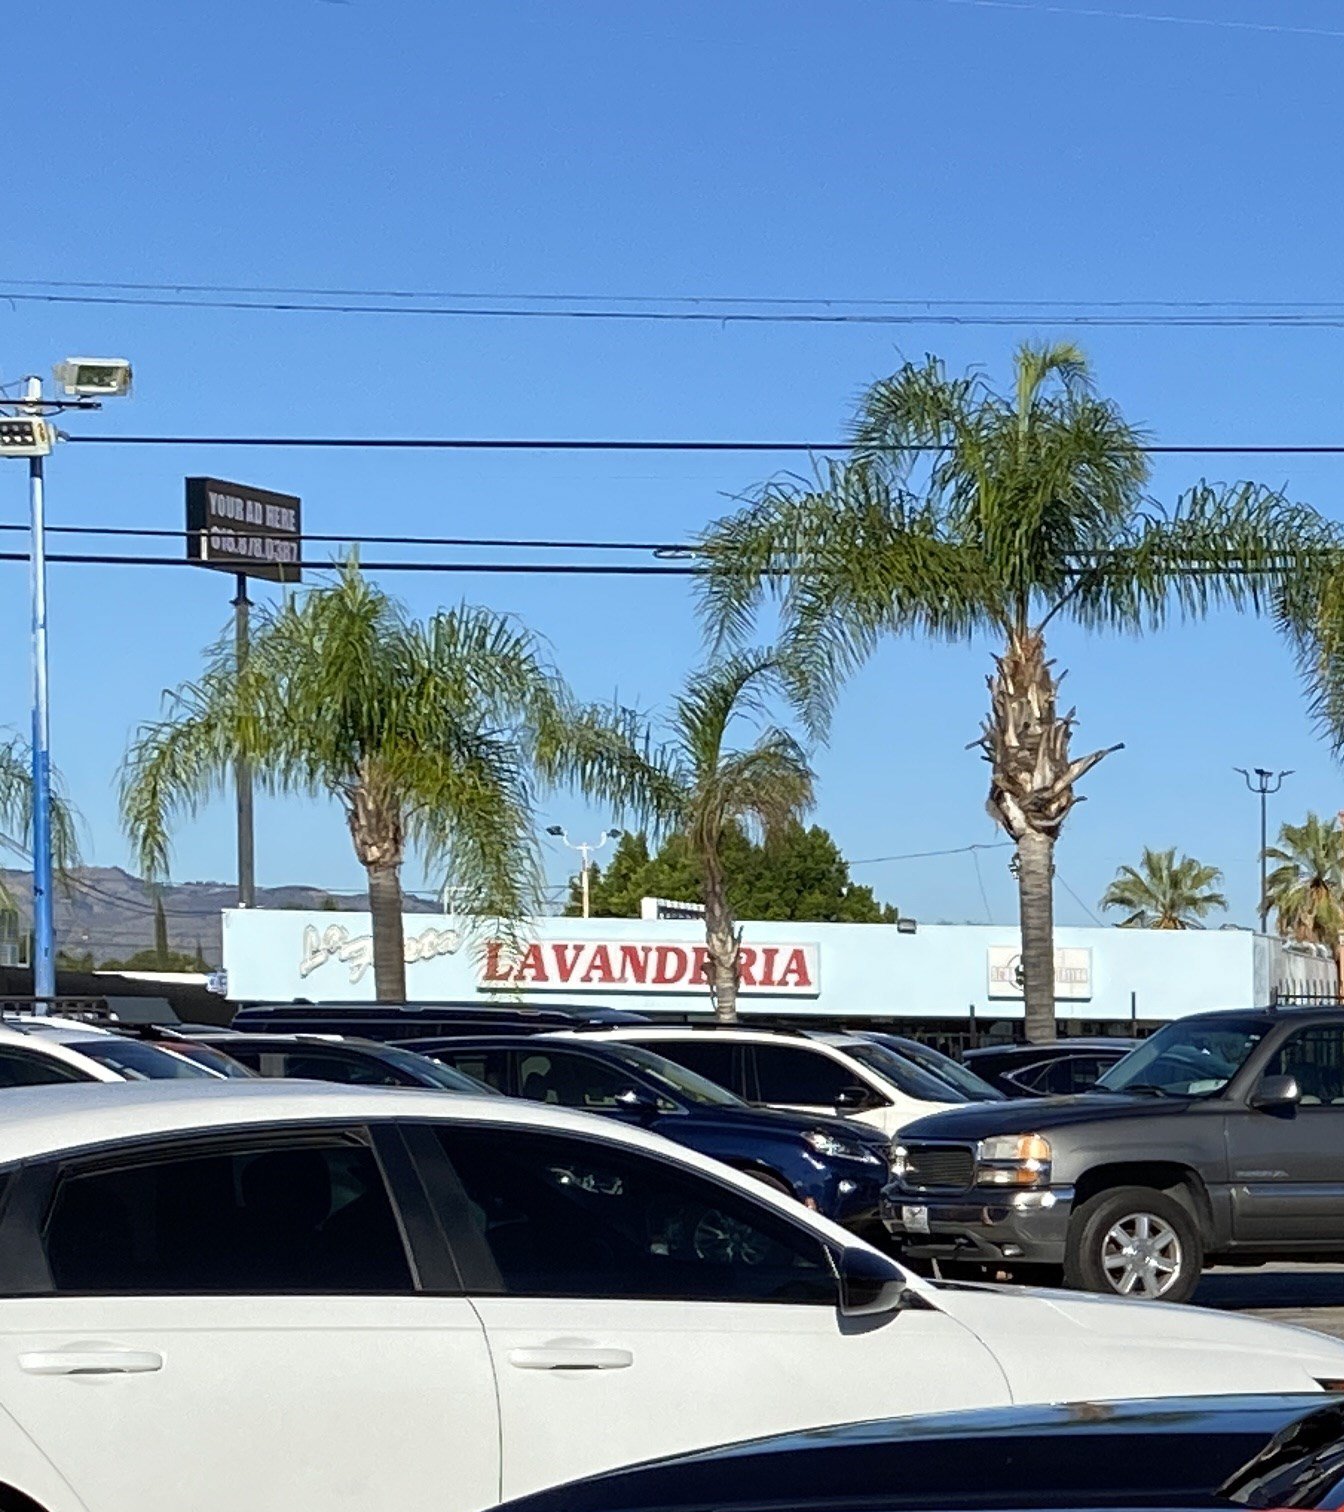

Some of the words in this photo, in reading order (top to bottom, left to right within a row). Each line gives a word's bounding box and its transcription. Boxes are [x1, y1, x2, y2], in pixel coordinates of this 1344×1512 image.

[209, 492, 244, 520] YOUR
[246, 500, 263, 525] AD
[266, 504, 297, 532] HERE
